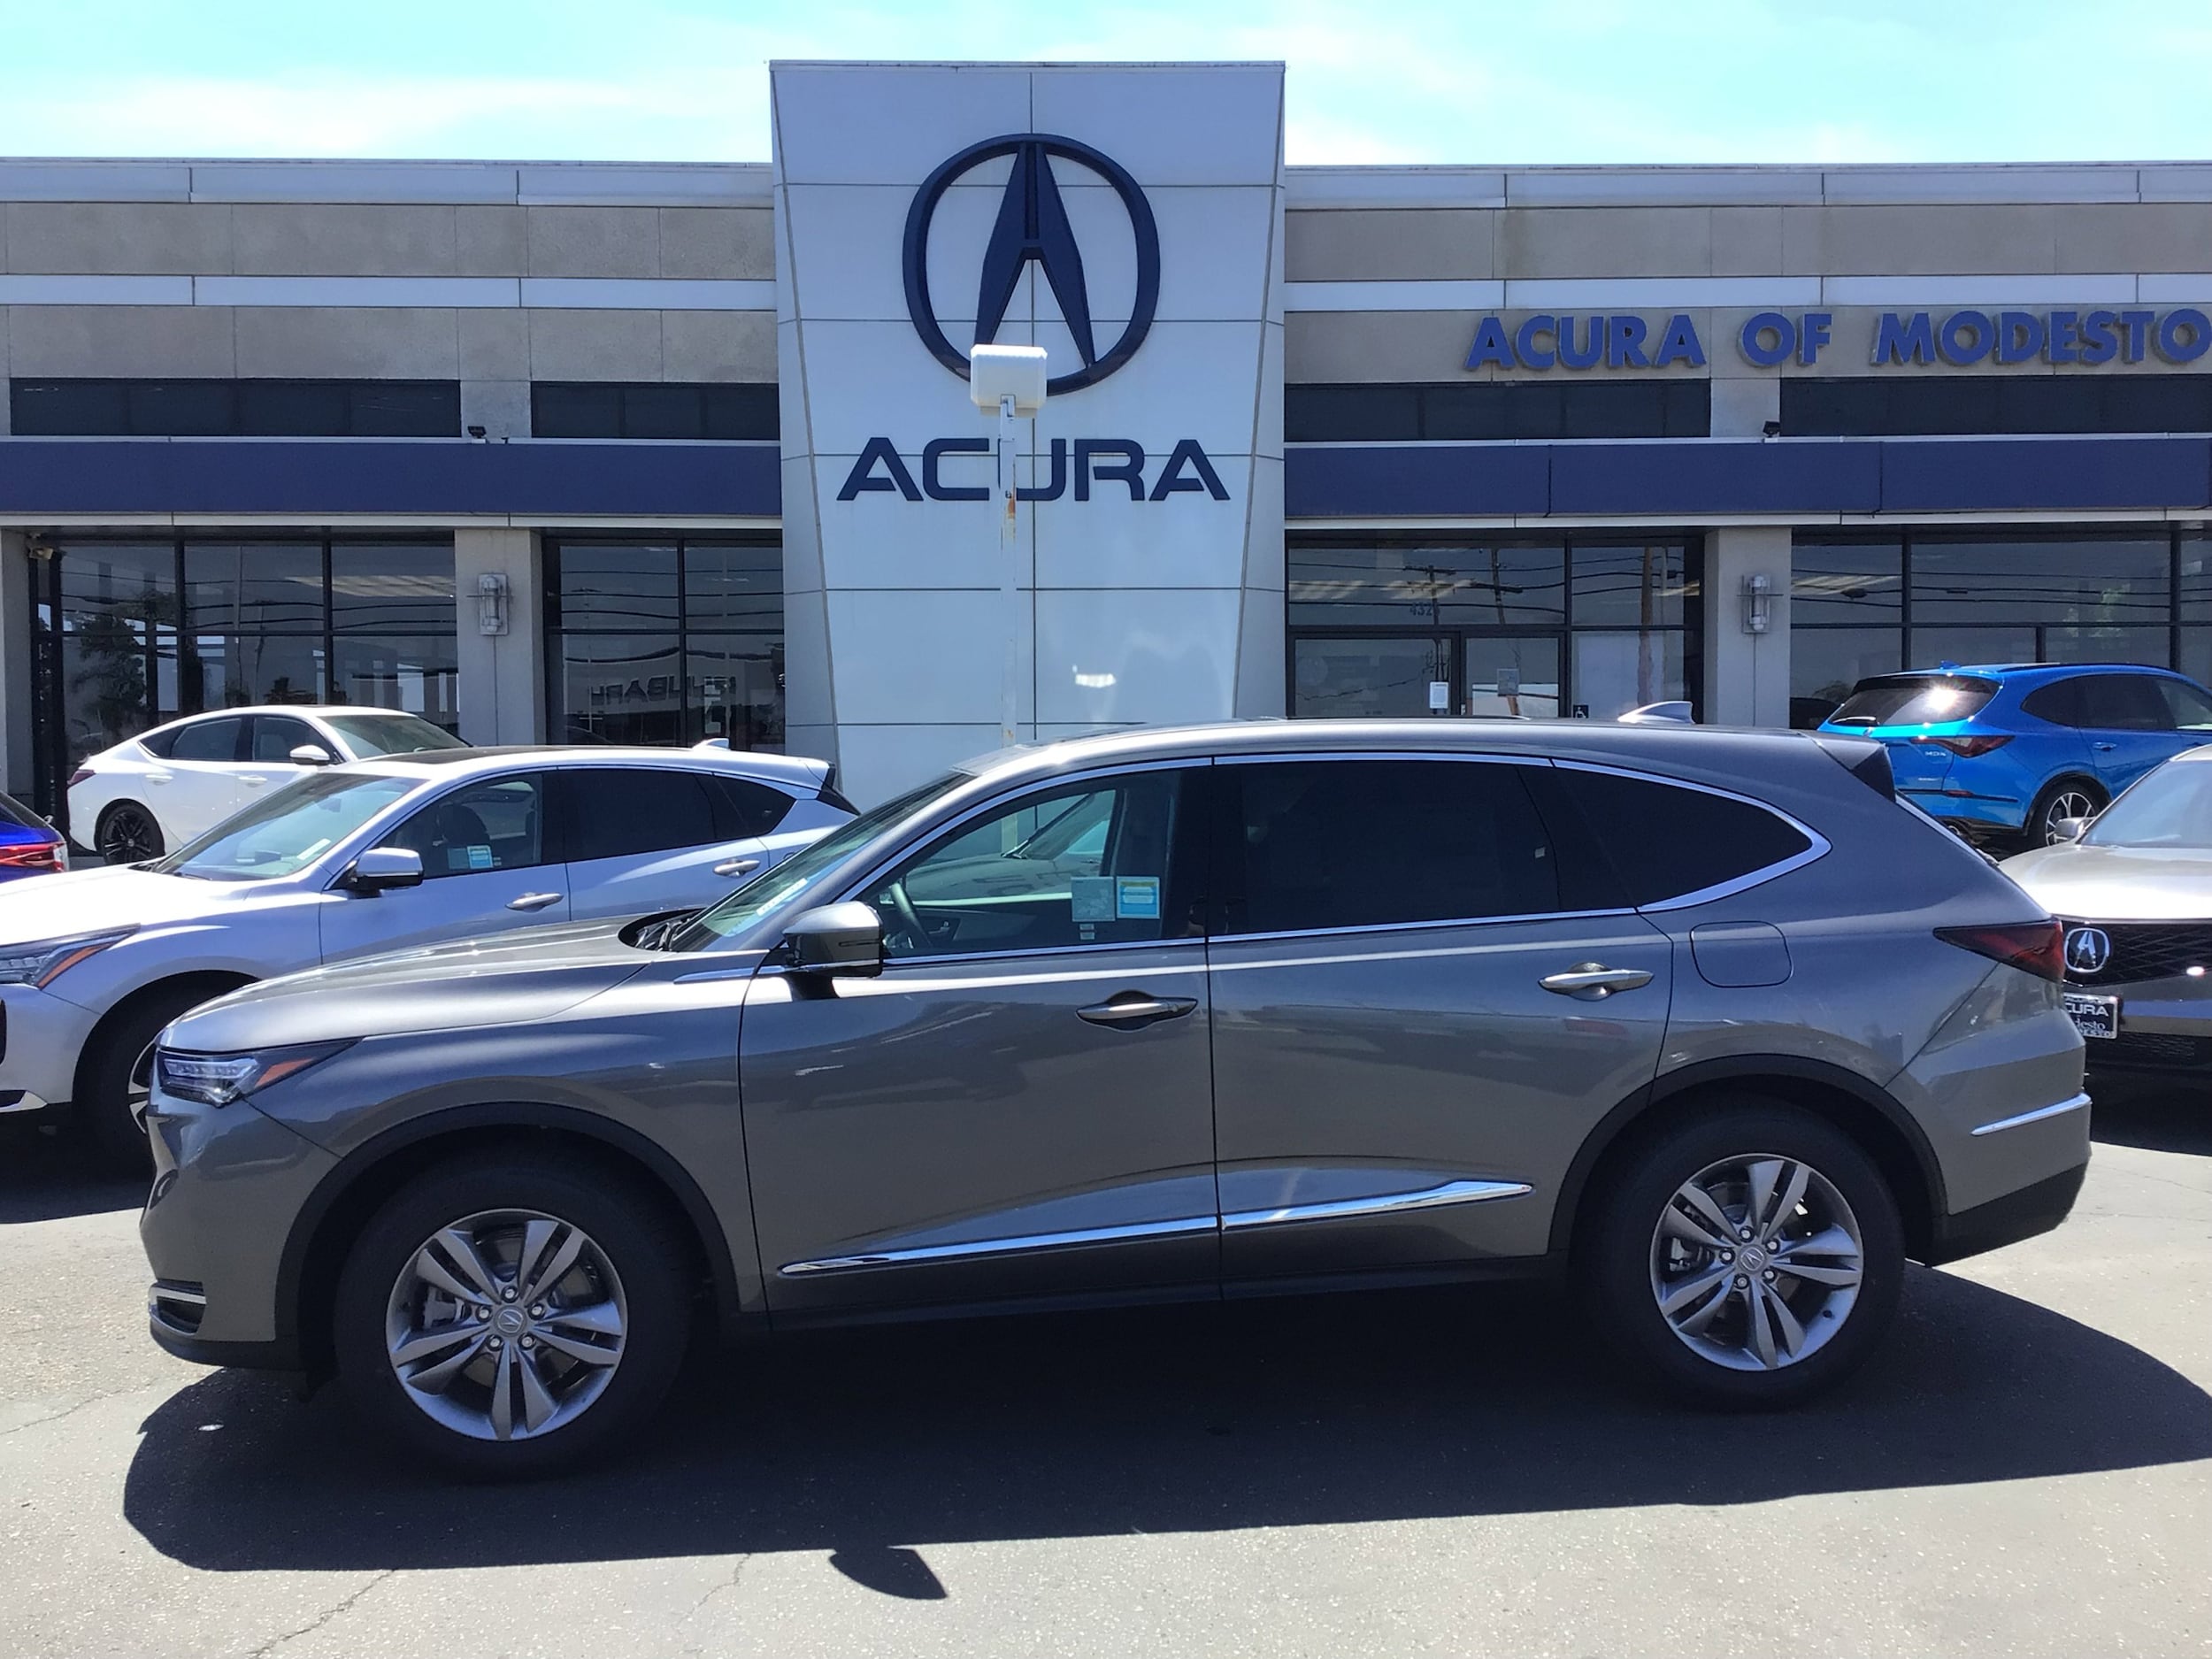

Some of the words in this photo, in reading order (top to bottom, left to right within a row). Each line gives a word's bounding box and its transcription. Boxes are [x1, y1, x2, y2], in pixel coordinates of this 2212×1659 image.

[1464, 313, 1707, 370] ACURA
[1740, 311, 1832, 367] OF
[1870, 308, 2212, 366] MODESTO
[836, 437, 1231, 502] ACURA
[2064, 1002, 2108, 1016] CURA
